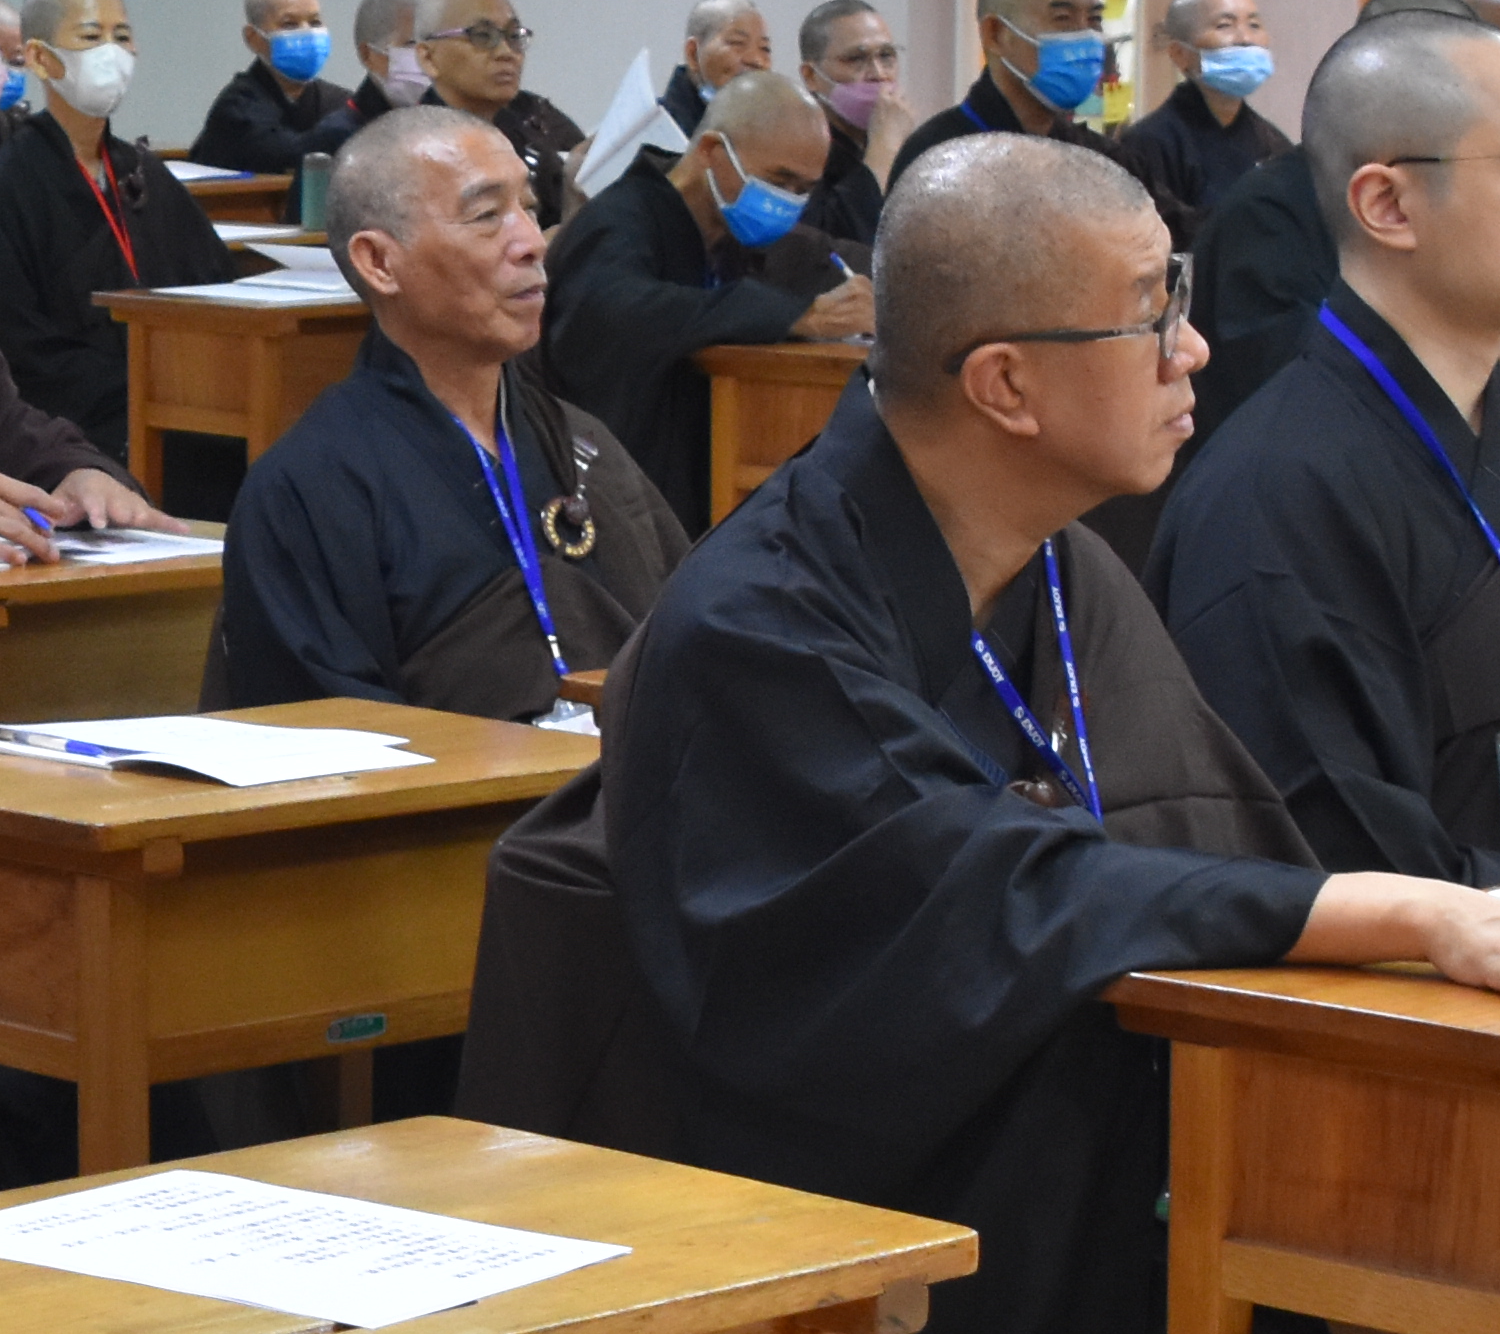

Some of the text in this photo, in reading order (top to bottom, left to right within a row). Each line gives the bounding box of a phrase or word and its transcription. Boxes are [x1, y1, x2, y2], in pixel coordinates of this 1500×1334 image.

[1051, 586, 1064, 619] ENJOY
[982, 652, 1004, 683] ENJOY
[1021, 718, 1046, 748] ENJOY
